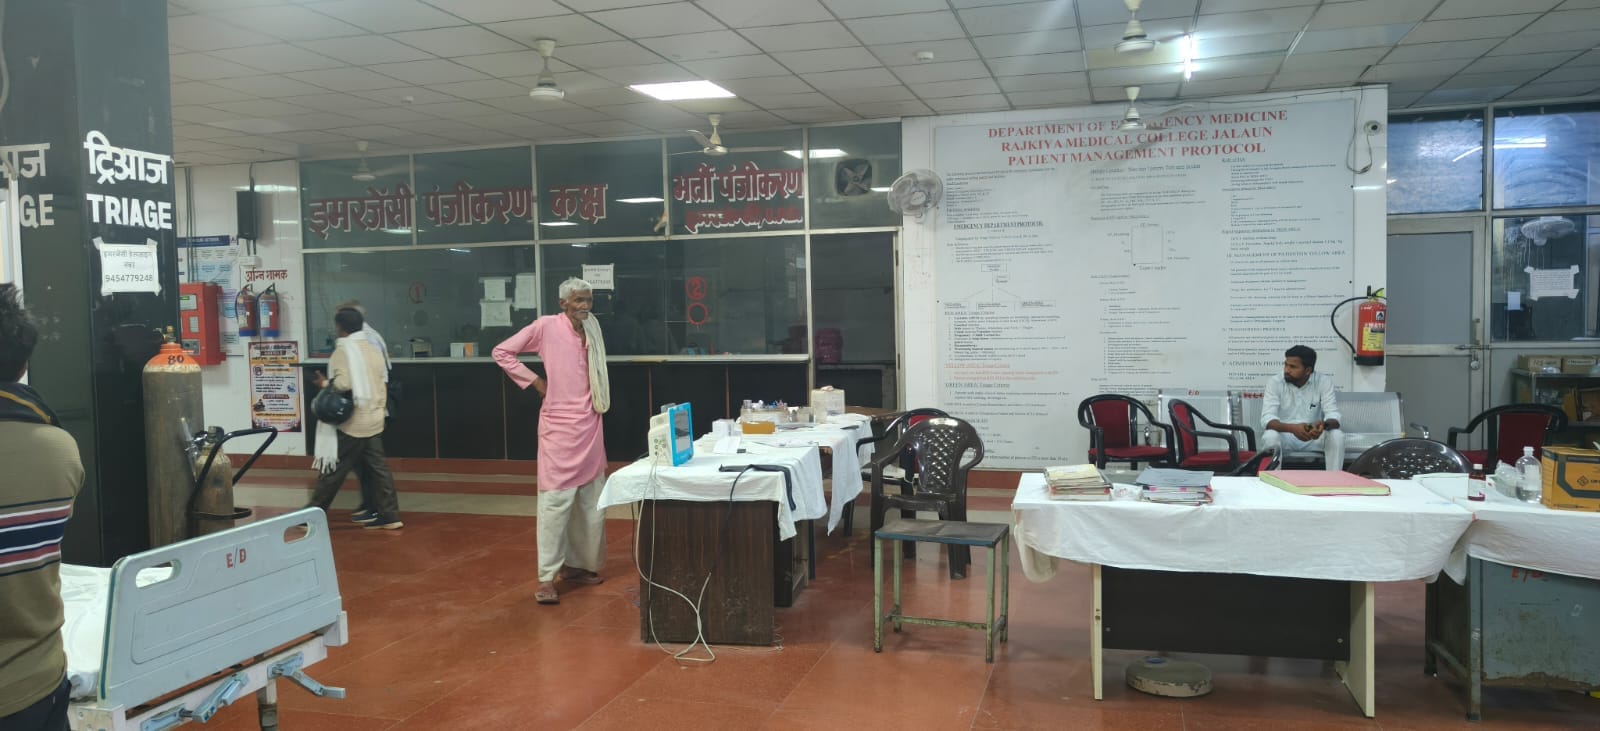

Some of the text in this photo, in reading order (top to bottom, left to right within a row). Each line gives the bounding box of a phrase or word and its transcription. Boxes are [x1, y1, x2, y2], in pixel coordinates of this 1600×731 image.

[988, 109, 1288, 138] DEPARTMENT OF EENCY MEDICINE
[1001, 126, 1273, 152] RAJKIYA MEDICAL COLLEGE JALAUN
[1008, 142, 1266, 166] PATIENT MANAGEMENT PROTOCOL
[720, 160, 805, 203] पंजीकरण
[86, 193, 173, 230] TRIAGE
[422, 180, 535, 227] पंजीकरण
[549, 183, 608, 224] कक्ष
[104, 273, 153, 282] 9454779248
[167, 354, 185, 366] 80
[226, 547, 247, 569] E/D
